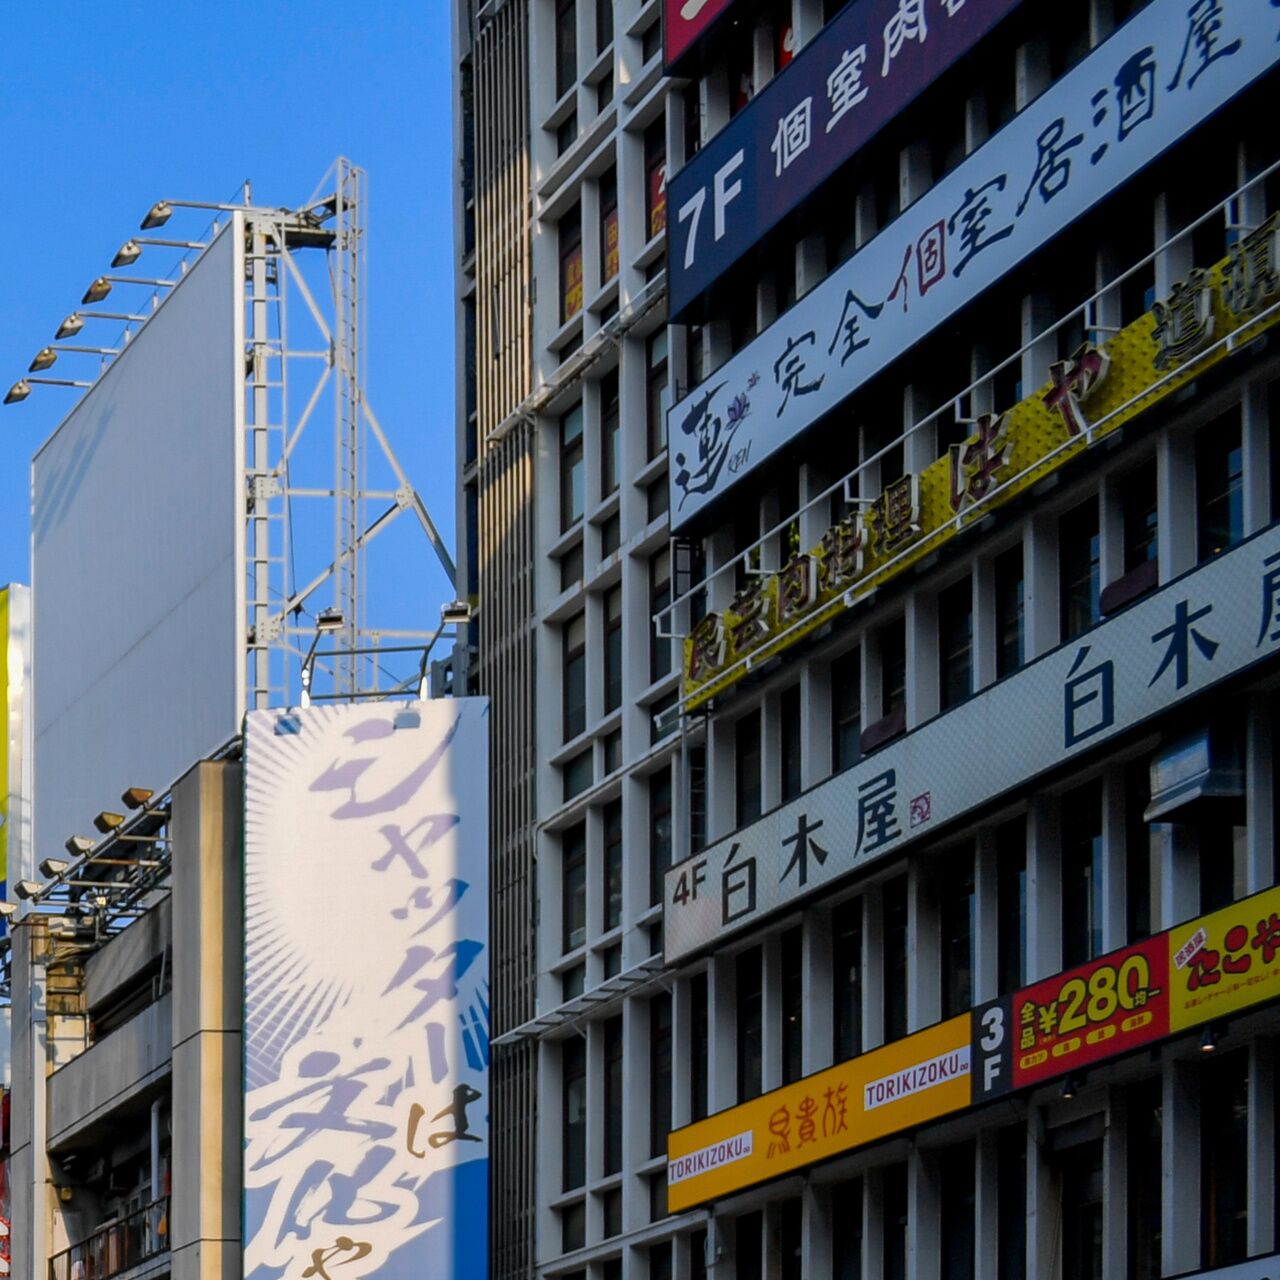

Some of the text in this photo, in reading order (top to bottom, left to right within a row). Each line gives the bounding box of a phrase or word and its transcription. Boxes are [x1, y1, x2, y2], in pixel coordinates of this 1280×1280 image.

[678, 150, 745, 270] 7F
[673, 769, 902, 925] 4F 白木屋
[1020, 1000, 1037, 1051] 全品
[1039, 954, 1150, 1036] ¥280
